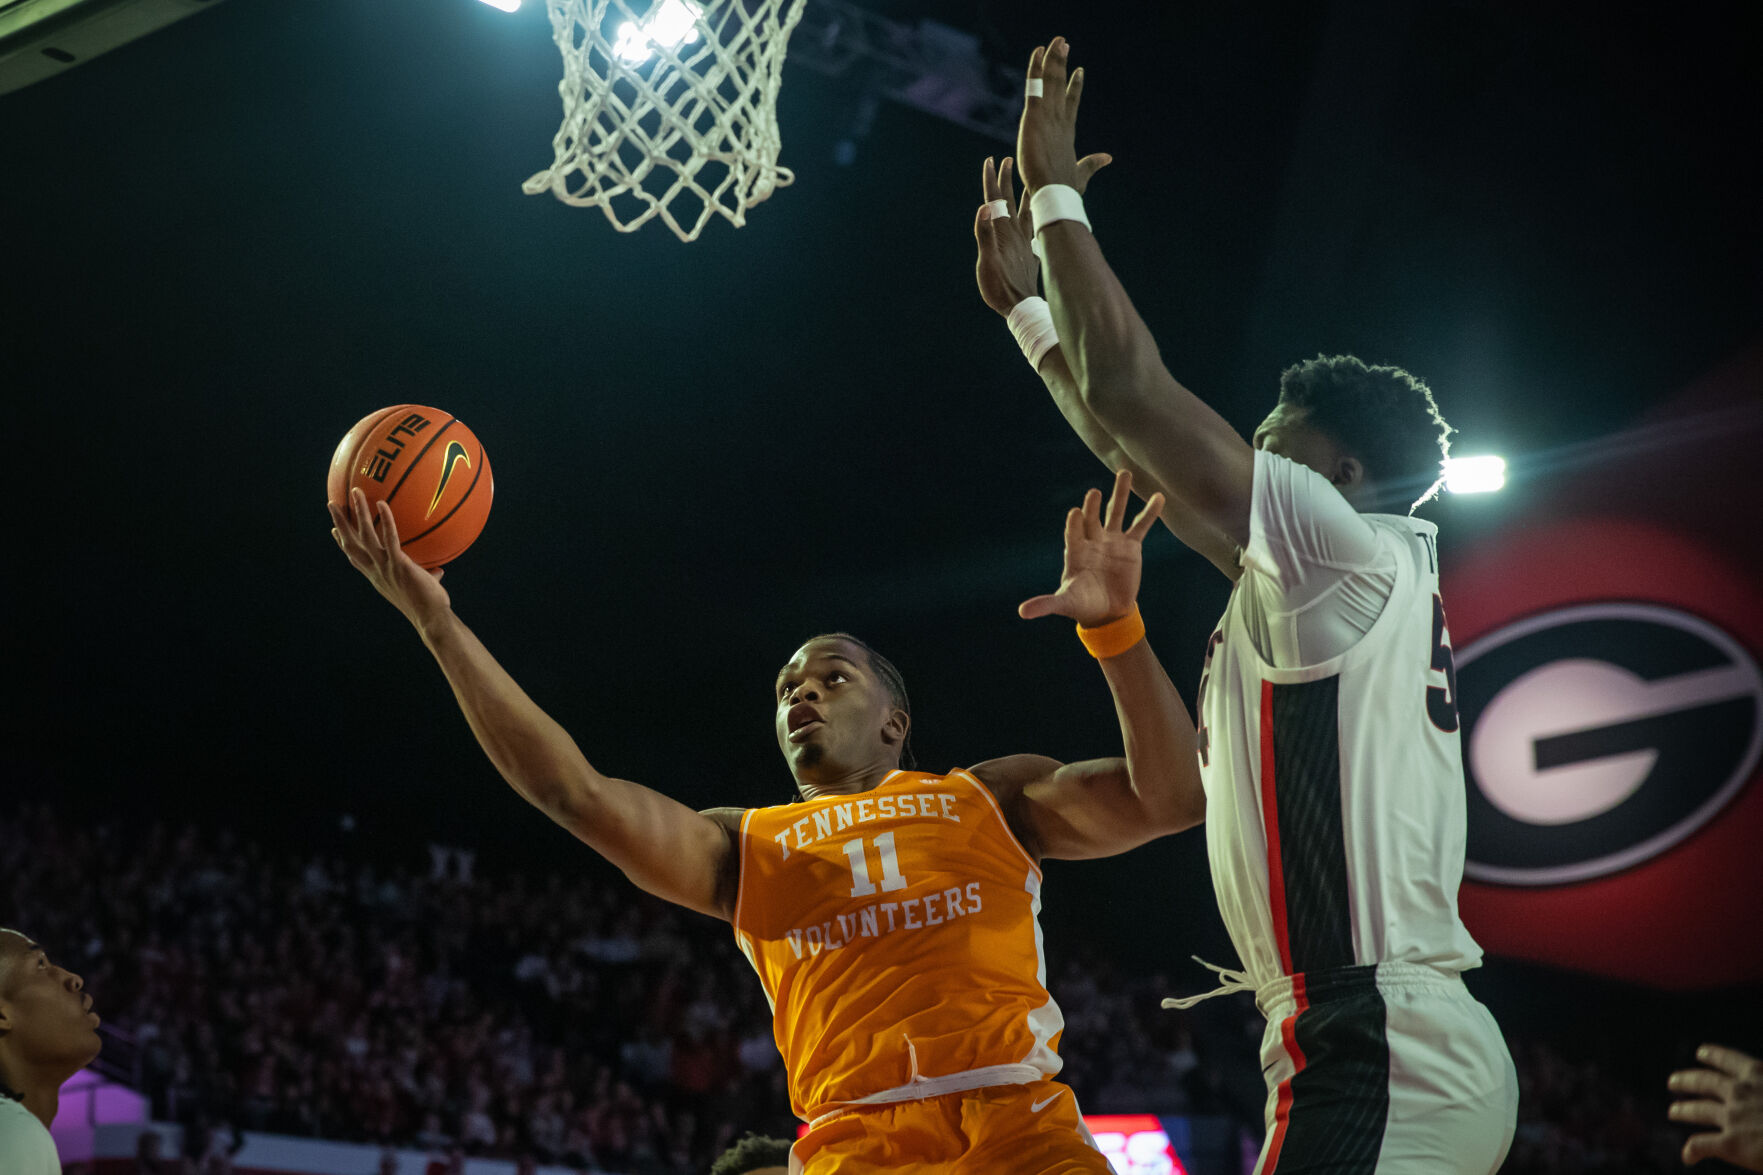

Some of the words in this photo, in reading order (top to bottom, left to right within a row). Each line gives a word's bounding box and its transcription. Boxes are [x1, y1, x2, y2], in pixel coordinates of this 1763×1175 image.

[367, 413, 431, 483] ELITE
[1470, 656, 1758, 826] G
[775, 794, 961, 862] TENNESSEE
[842, 831, 908, 898] 11
[785, 882, 983, 960] VOLUNTEERS
